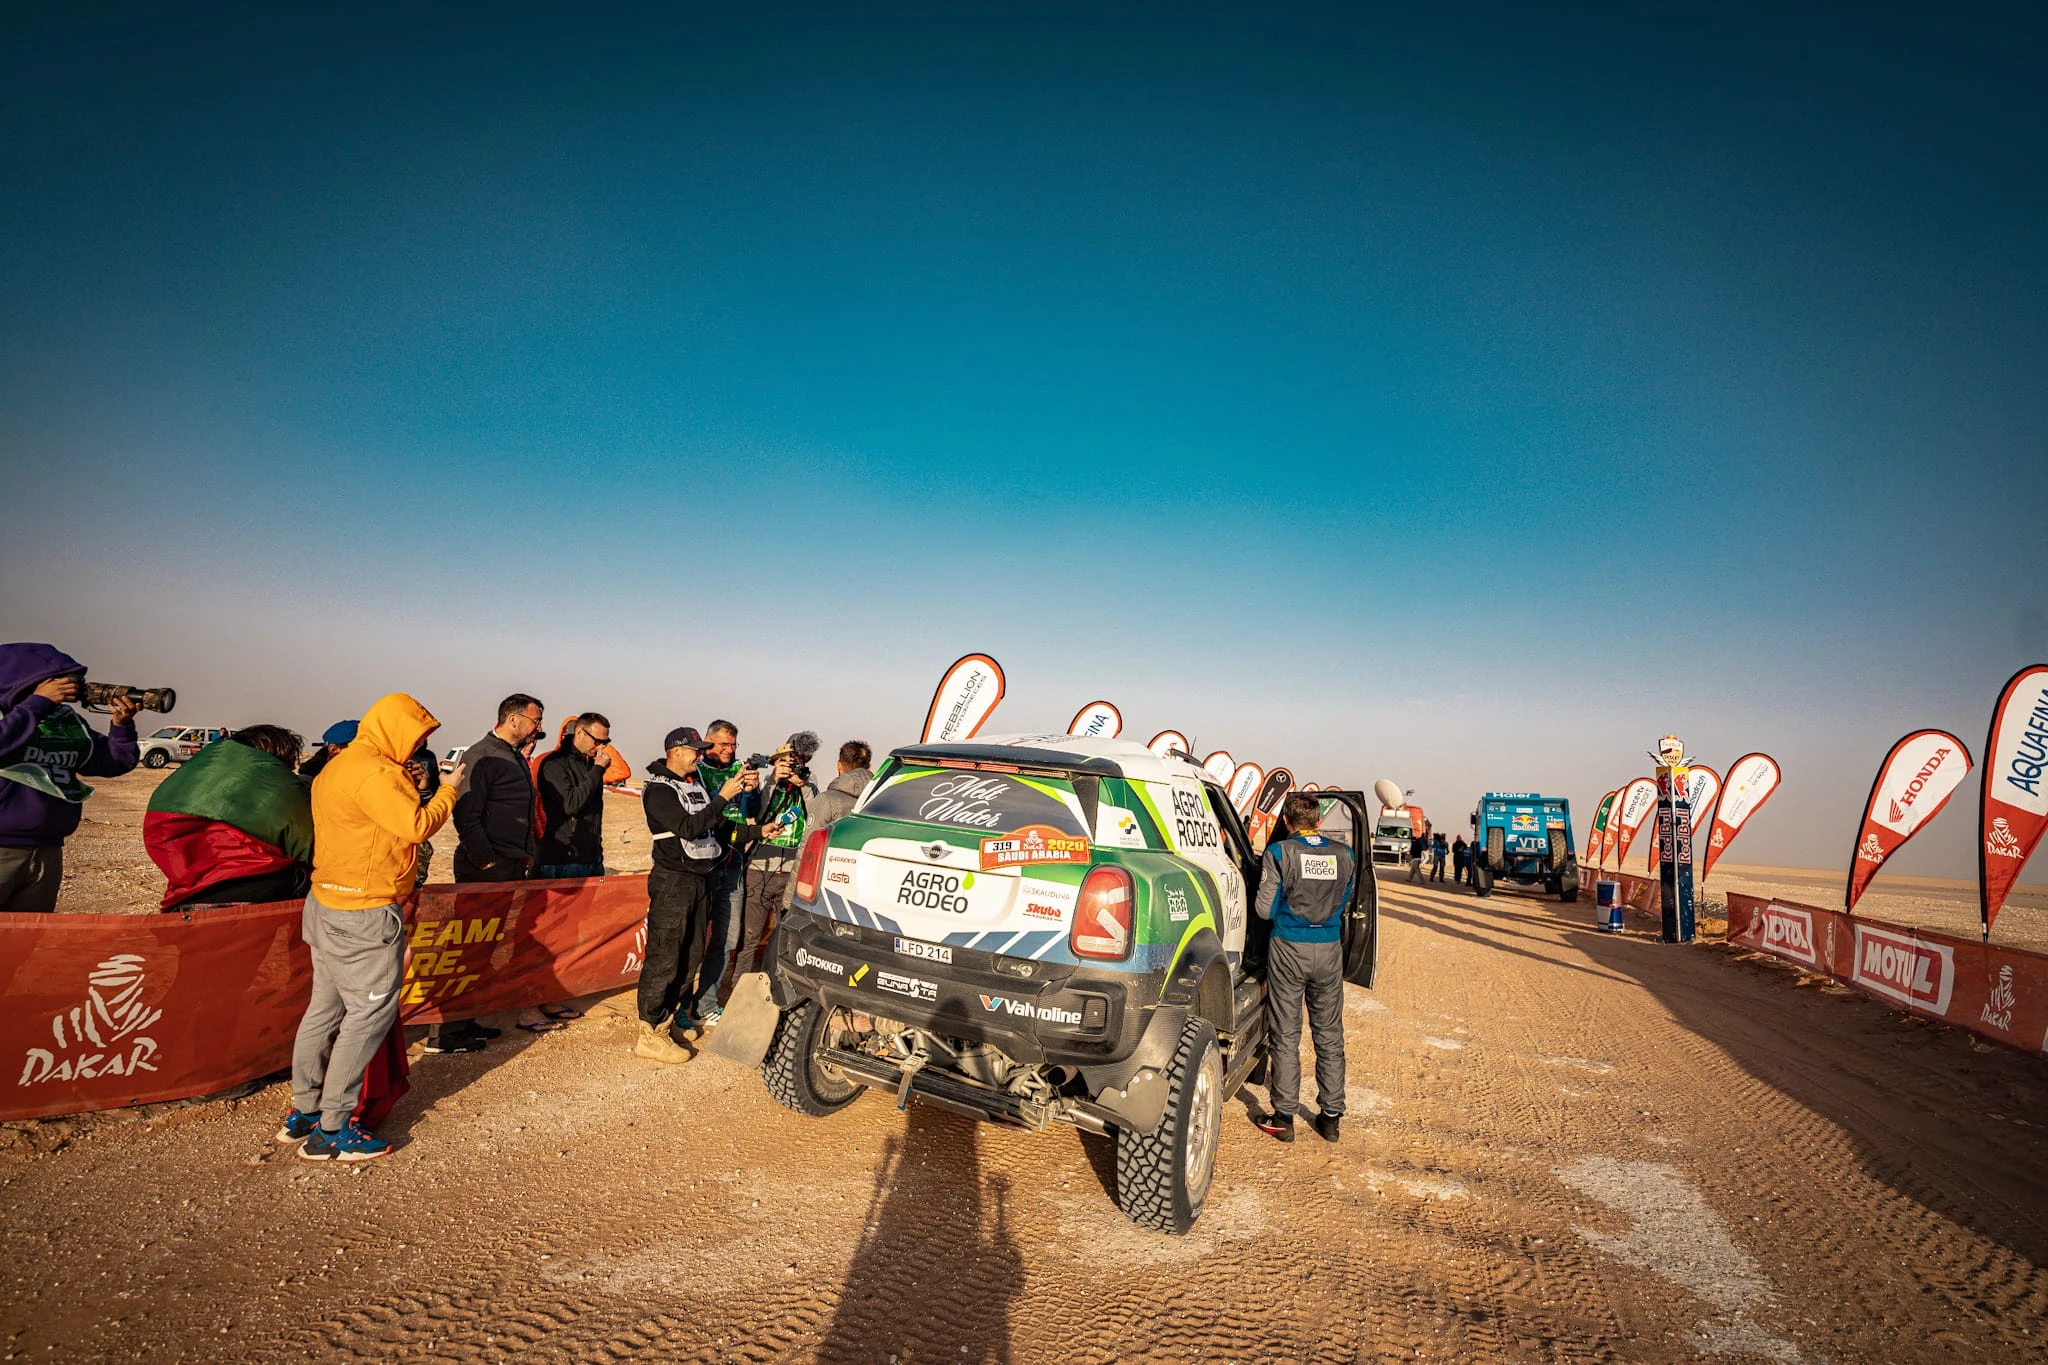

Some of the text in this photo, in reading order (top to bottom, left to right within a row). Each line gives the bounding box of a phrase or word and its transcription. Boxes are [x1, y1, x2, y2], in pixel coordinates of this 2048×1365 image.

[940, 670, 981, 741] REBELLION
[2006, 688, 2048, 797] AQUAFIN
[930, 774, 1011, 801] Melt
[1900, 748, 1951, 806] HONDA
[919, 797, 1003, 828] Water
[1171, 787, 1205, 819] AGRO
[992, 841, 1012, 852] 319
[1047, 839, 1084, 851] 2020
[1176, 818, 1217, 848] RODEO
[1519, 837, 1547, 849] VTB
[1659, 807, 1673, 863] Red Bull
[1676, 808, 1692, 864] Red Bull
[997, 850, 1071, 863] SAUDI ARABIA
[1304, 859, 1329, 868] AGRO
[1987, 841, 2025, 860] DAKAR
[901, 870, 959, 893] AGRO
[1305, 867, 1335, 876] RODEO
[896, 887, 969, 914] RODEO
[901, 941, 950, 960] LFD 214
[806, 955, 844, 976] STOKKER
[1863, 940, 1934, 994] MOTUL
[1004, 998, 1082, 1025] Valvoline
[1980, 1003, 2012, 1032] DAKAR
[18, 1037, 159, 1087] DAKAR
